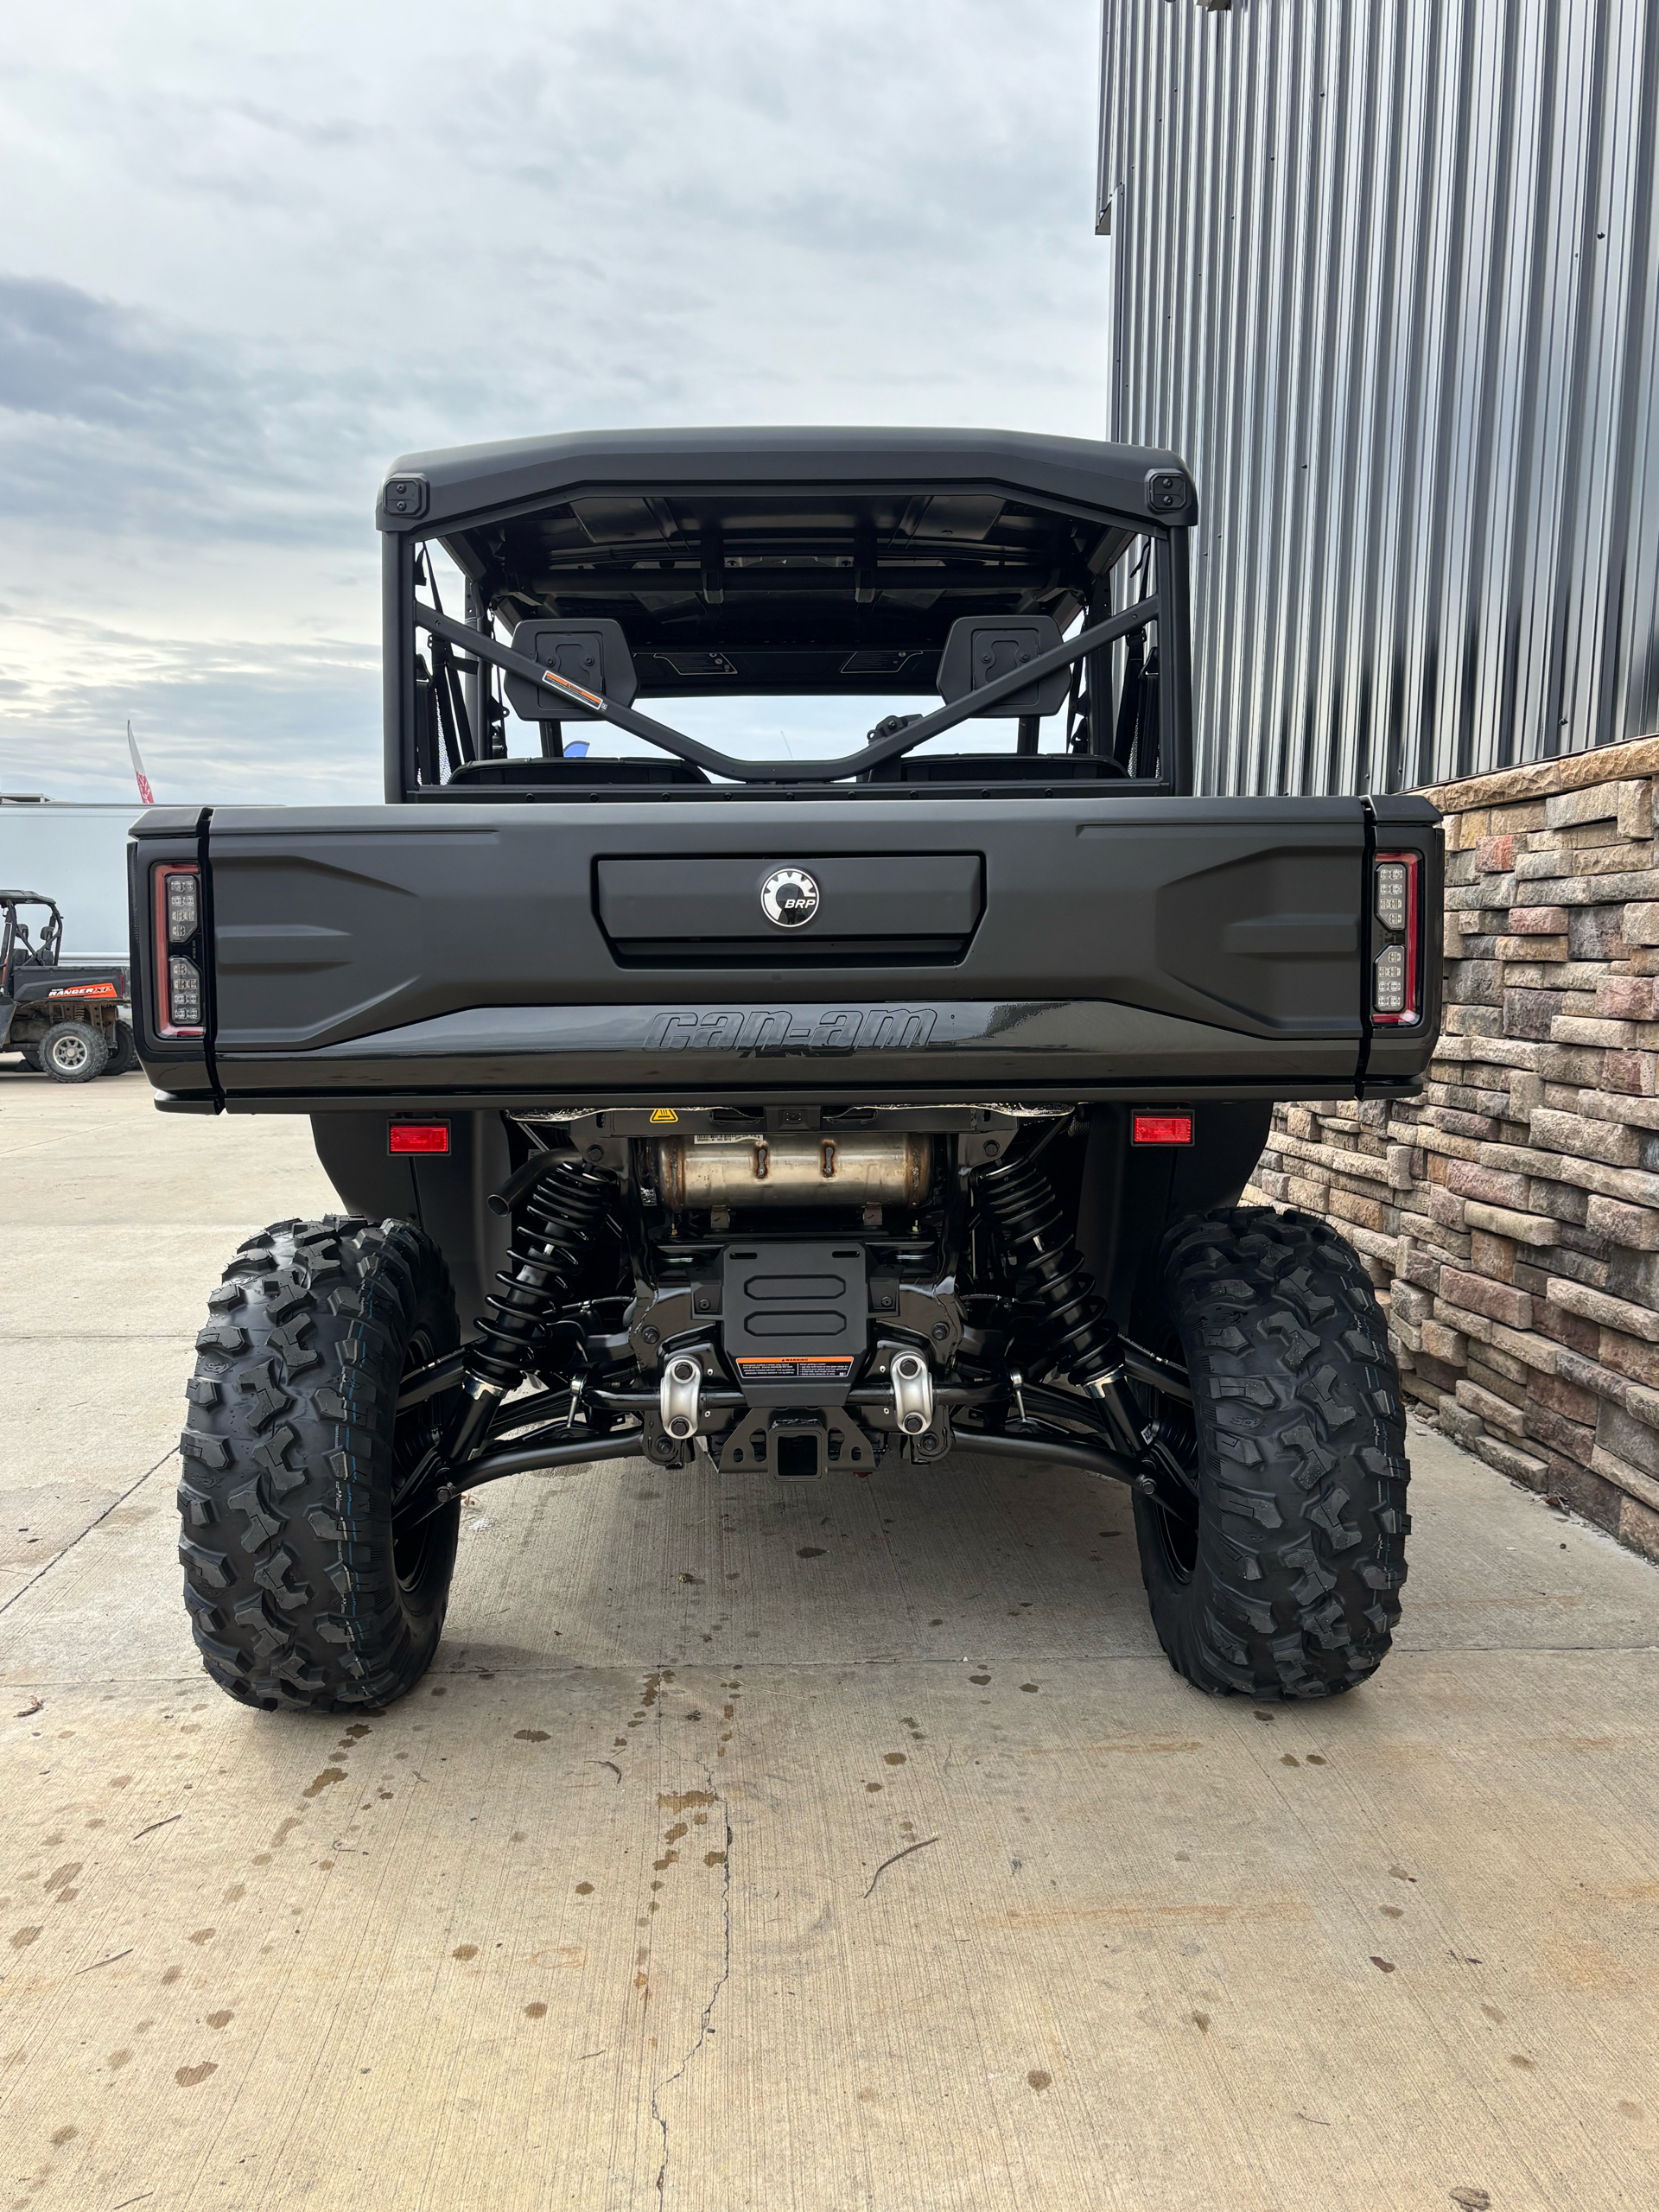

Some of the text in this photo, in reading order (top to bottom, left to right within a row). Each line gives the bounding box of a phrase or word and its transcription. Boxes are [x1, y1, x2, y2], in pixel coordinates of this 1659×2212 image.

[784, 899, 816, 909] BRP
[48, 988, 94, 996] RANGER
[642, 1008, 938, 1053] can-am
